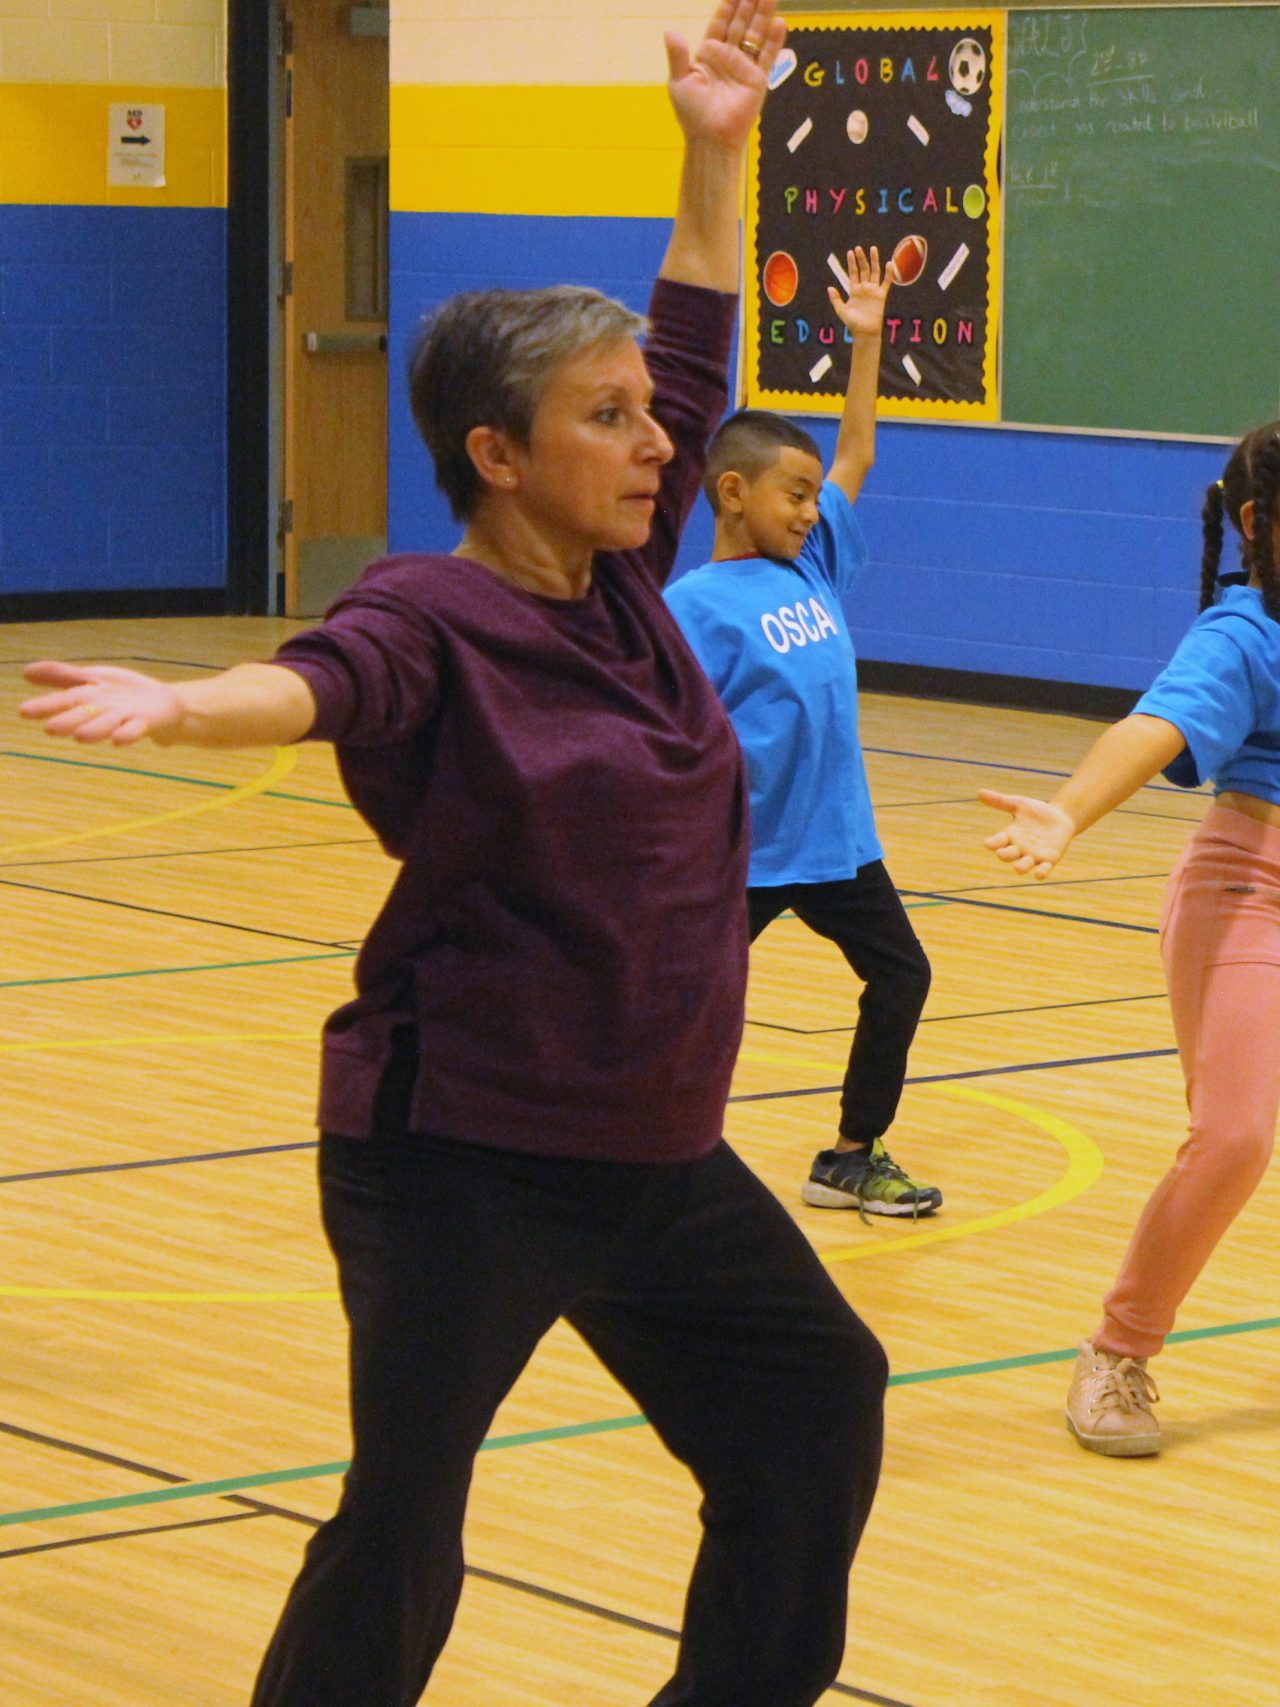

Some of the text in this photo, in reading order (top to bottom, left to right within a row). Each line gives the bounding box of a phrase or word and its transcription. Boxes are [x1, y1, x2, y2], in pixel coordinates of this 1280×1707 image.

[804, 56, 939, 87] GLOBAL
[784, 186, 959, 215] PHYSICAL
[770, 318, 974, 345] EDUTION
[760, 597, 839, 654] OSCA
